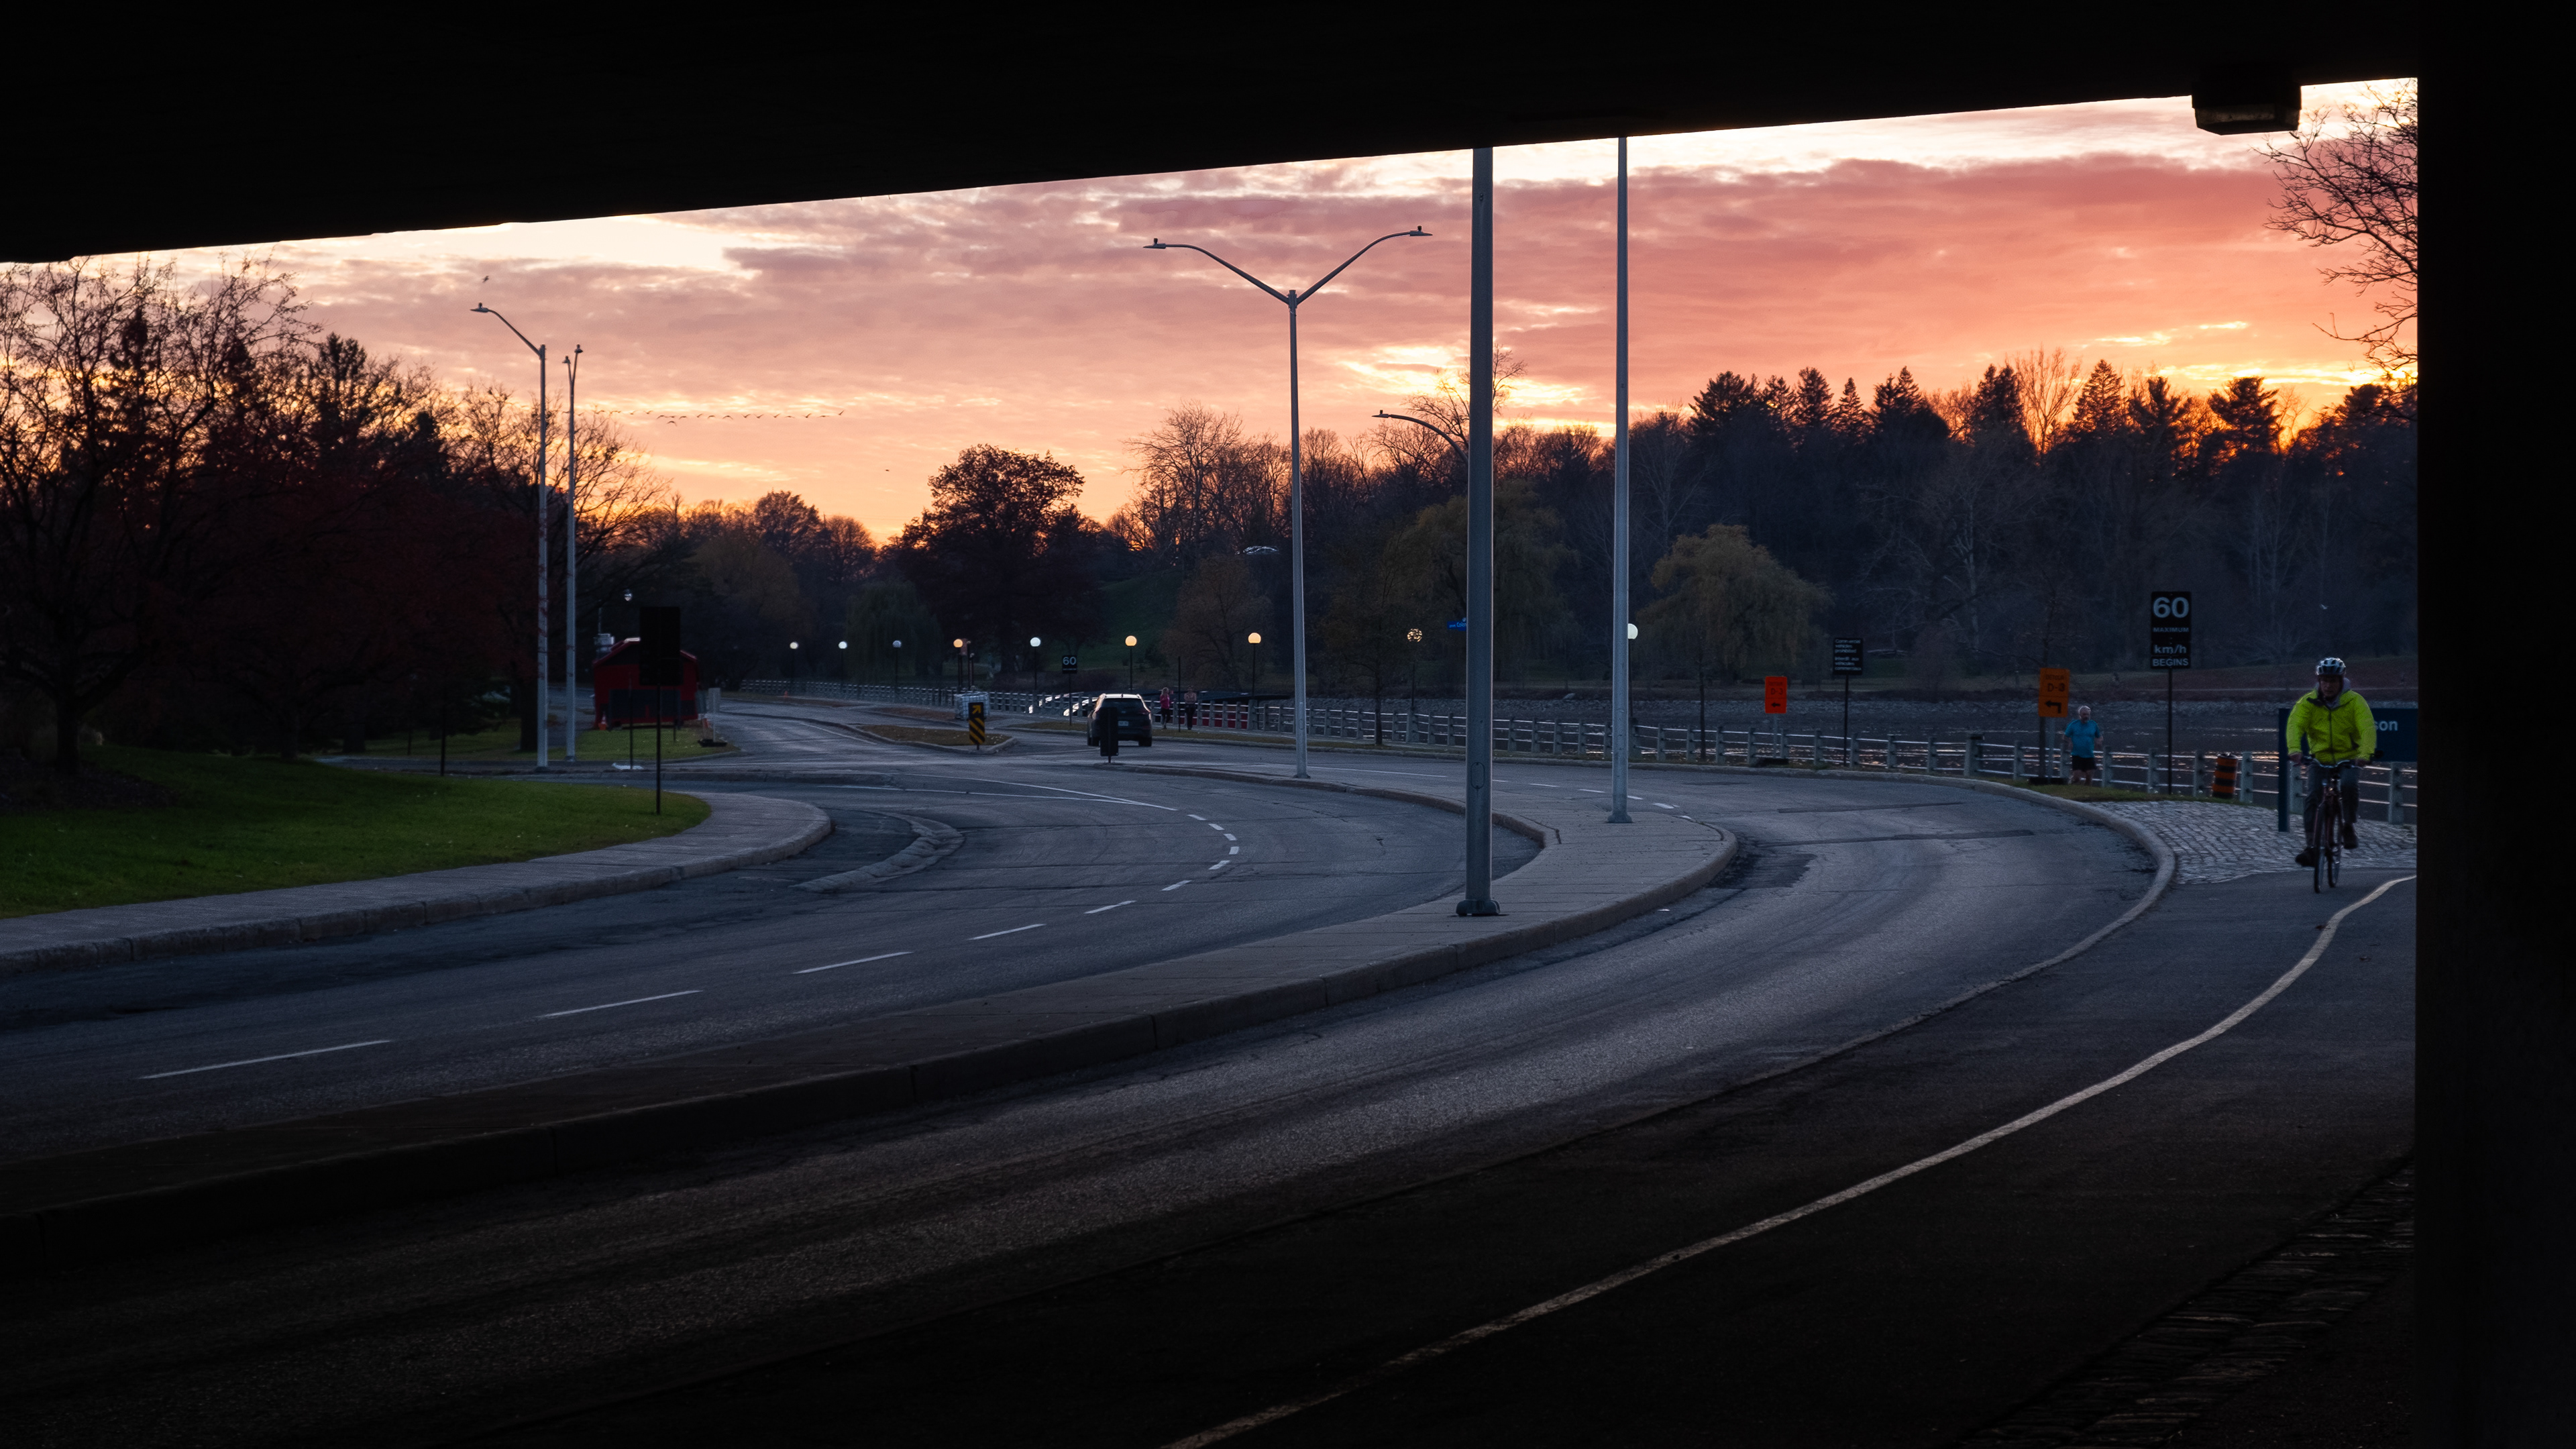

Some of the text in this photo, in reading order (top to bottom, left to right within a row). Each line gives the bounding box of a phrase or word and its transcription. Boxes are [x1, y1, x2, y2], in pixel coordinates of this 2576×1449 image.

[2153, 596, 2190, 619] 60
[2154, 644, 2187, 654] km/h
[1063, 656, 1077, 665] 60
[2152, 658, 2189, 667] BEGINS
